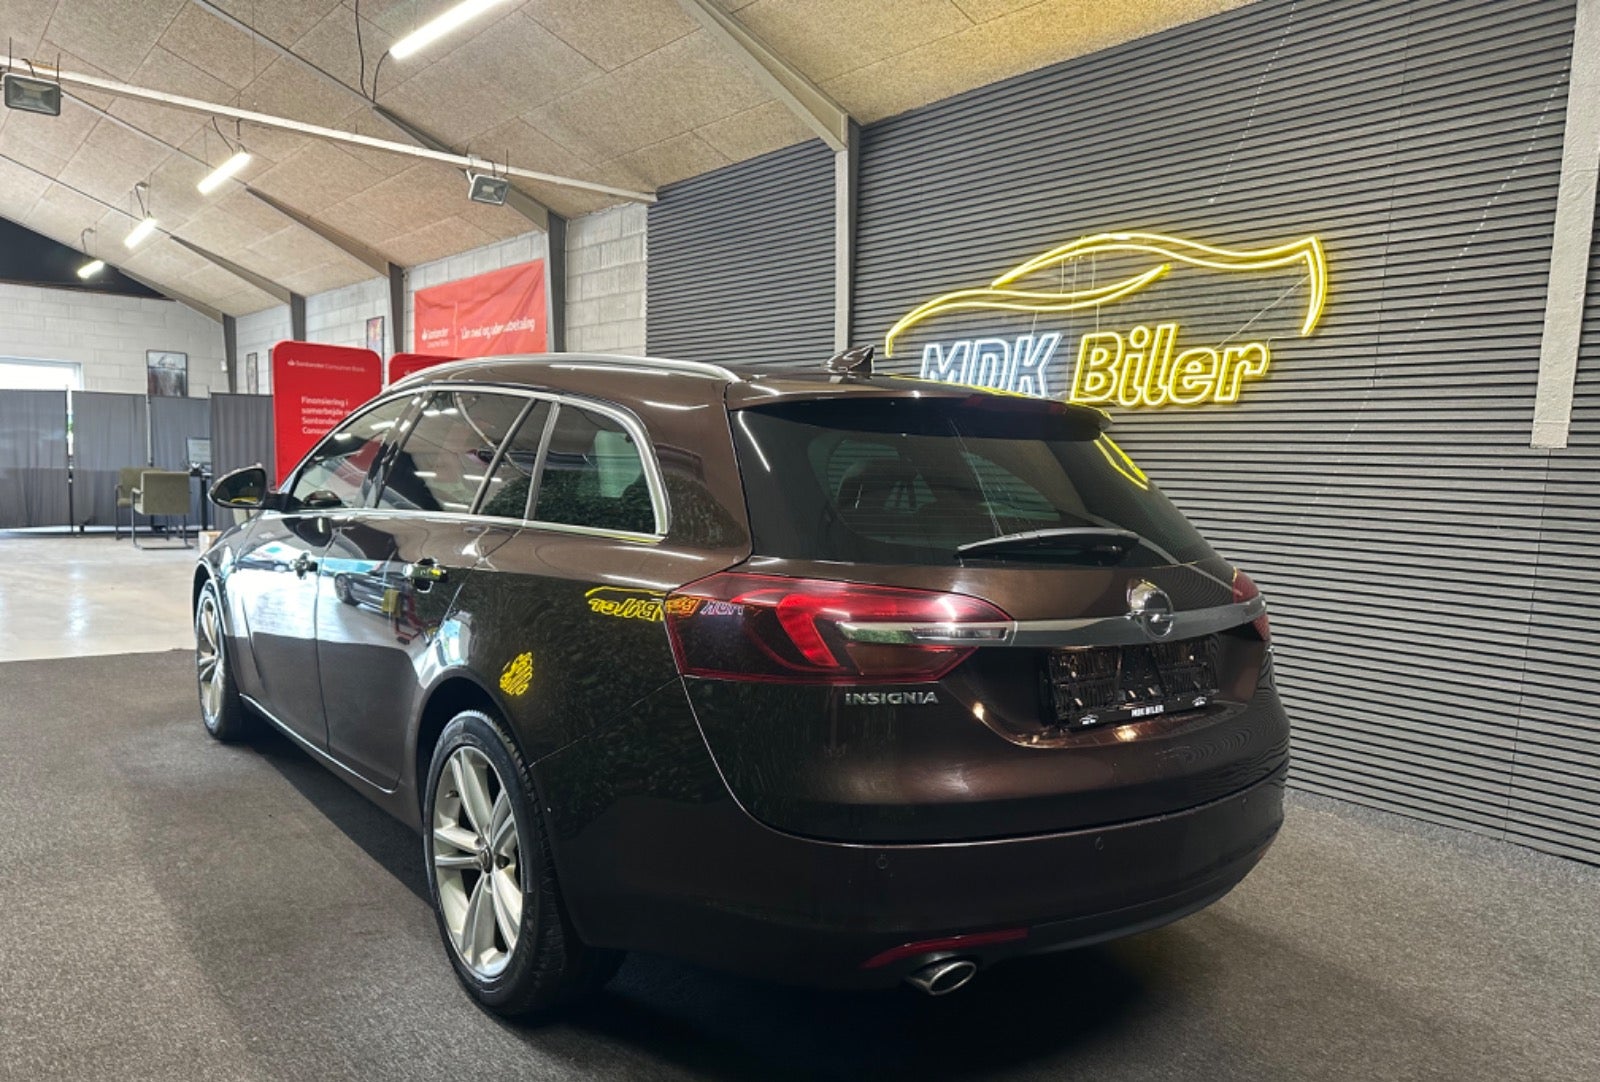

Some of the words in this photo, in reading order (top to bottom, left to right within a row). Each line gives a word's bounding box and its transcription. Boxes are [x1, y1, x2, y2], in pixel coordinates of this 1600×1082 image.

[920, 332, 1063, 399] MDK
[1069, 322, 1271, 407] Biler
[845, 691, 939, 705] INSIGNIA
